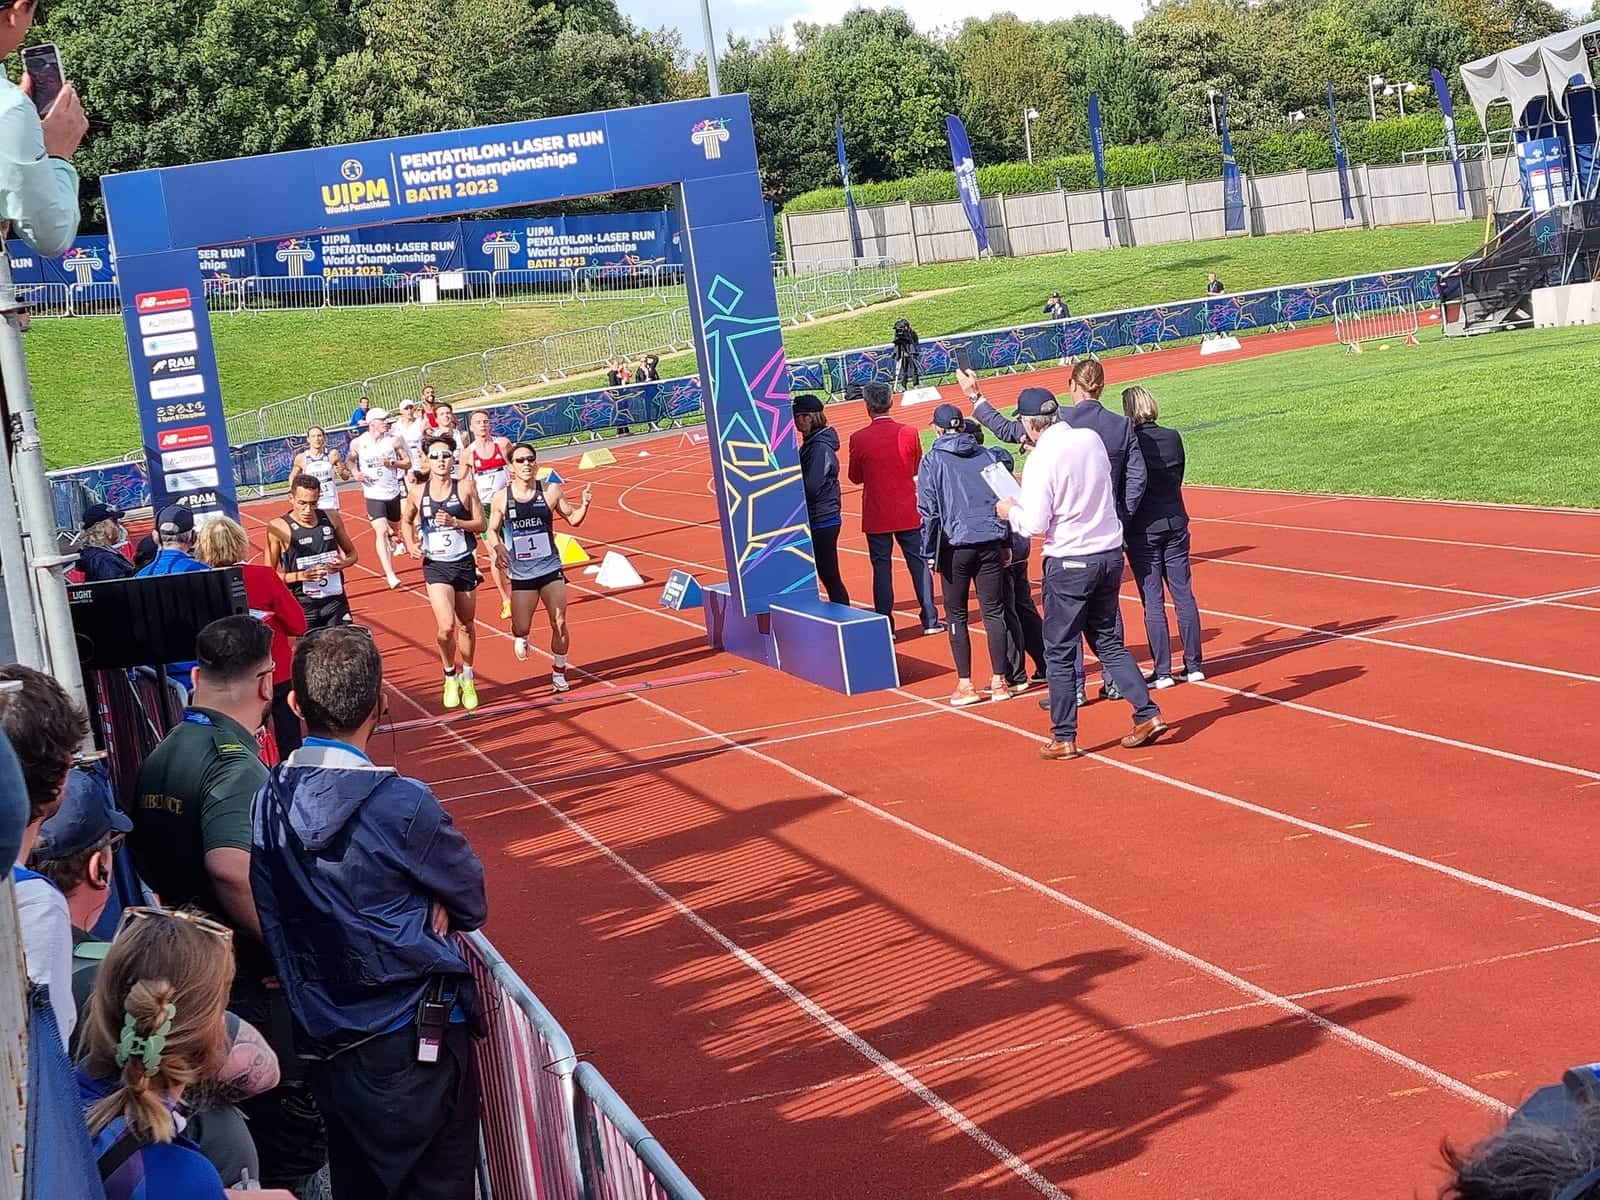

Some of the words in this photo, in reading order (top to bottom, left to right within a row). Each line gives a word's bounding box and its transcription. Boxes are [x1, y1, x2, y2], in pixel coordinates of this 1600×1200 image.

[567, 129, 604, 148] RUN
[402, 164, 443, 185] World
[455, 152, 578, 178] Championships
[321, 178, 389, 206] UIPM
[405, 184, 452, 203] BATH
[455, 178, 499, 197] 2023
[324, 204, 349, 215] World
[349, 200, 391, 212] Pentathlon
[526, 226, 554, 237] UIPM
[631, 230, 656, 240] RUN
[321, 234, 351, 245] UIPM
[431, 240, 455, 251] RUN
[198, 249, 219, 259] SER
[220, 247, 246, 258] RUN
[527, 245, 559, 257] World
[559, 242, 637, 256] Championships
[322, 254, 355, 266] World
[357, 252, 436, 265] Championships
[527, 258, 556, 269] BATH
[559, 256, 586, 268] 2023
[322, 266, 353, 278] BATH
[356, 265, 384, 276] 2023
[168, 356, 195, 369] RAM
[488, 474, 496, 486] 7
[189, 493, 216, 505] RAM
[511, 517, 544, 530] KOREA
[442, 533, 452, 547] 3
[528, 537, 537, 551] 1
